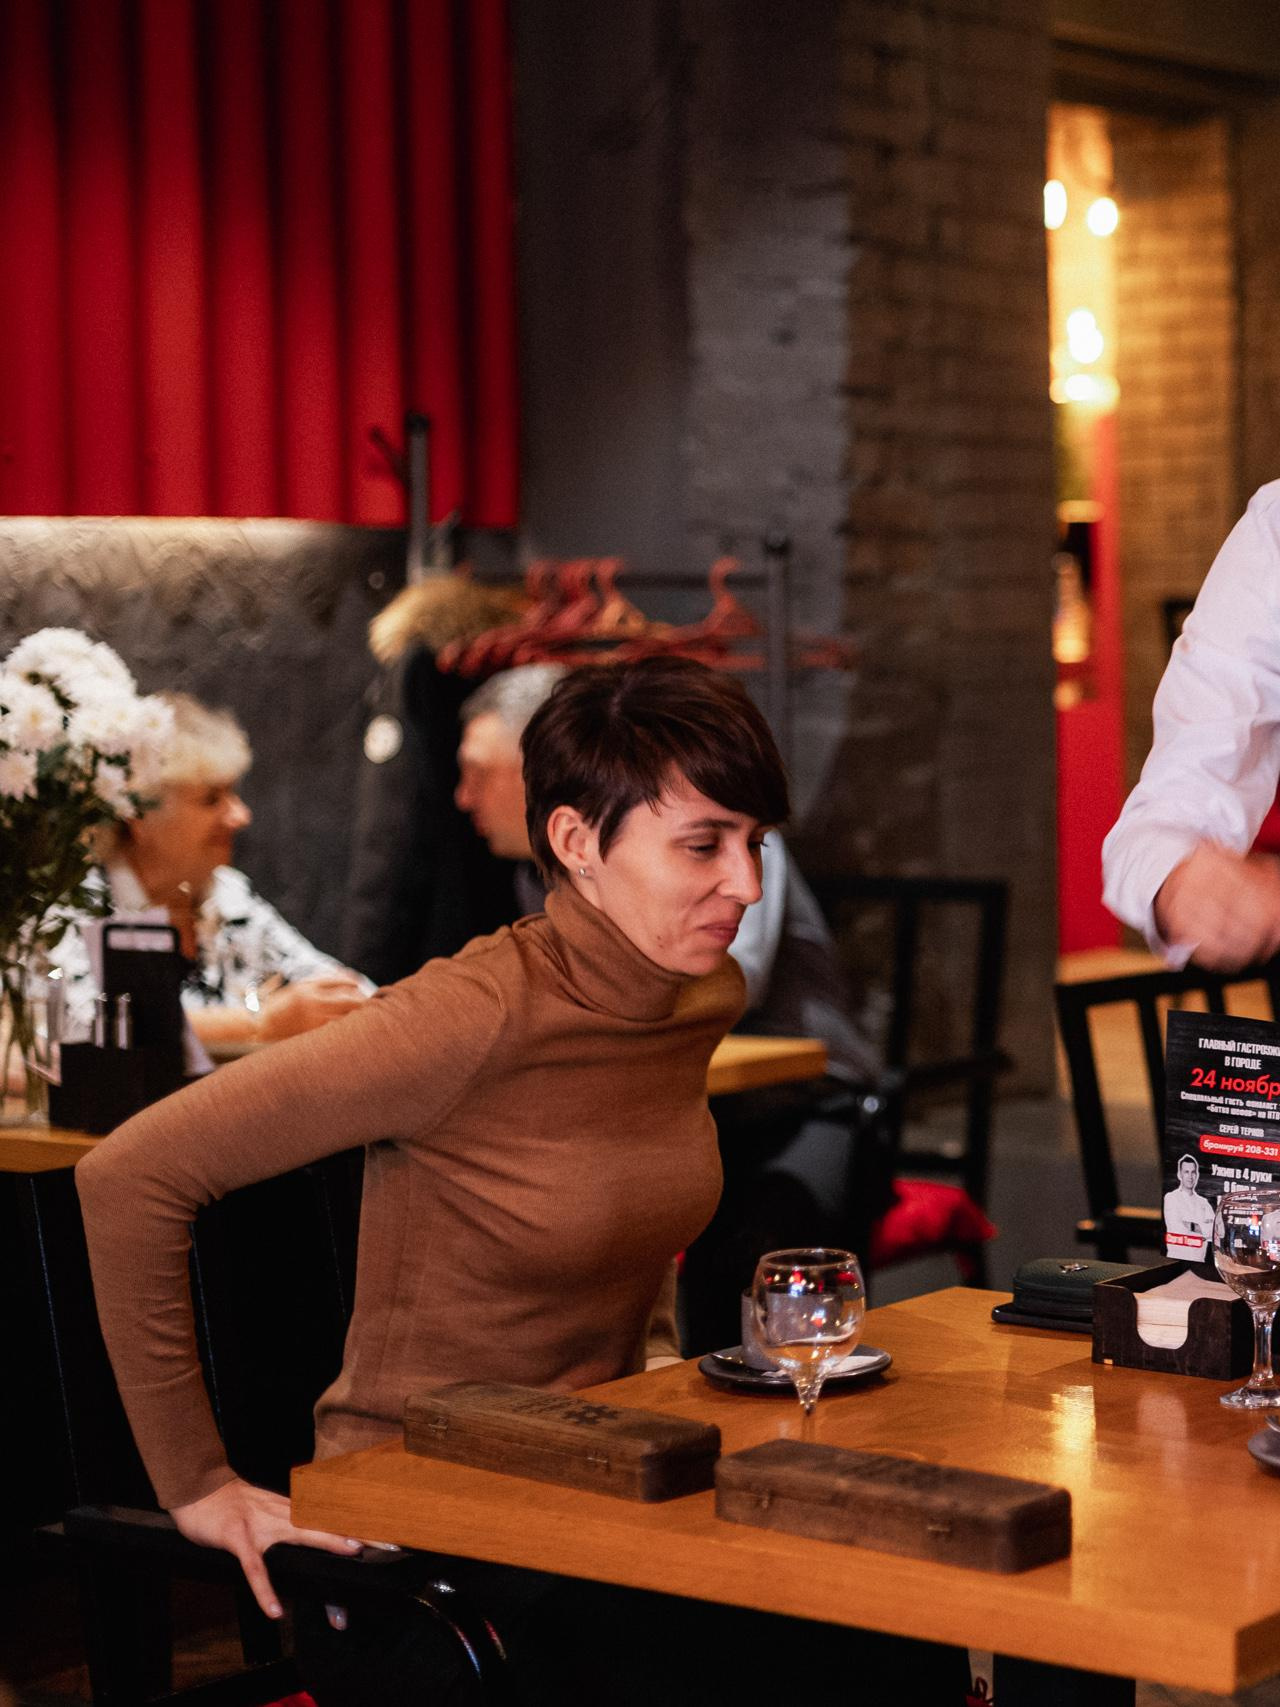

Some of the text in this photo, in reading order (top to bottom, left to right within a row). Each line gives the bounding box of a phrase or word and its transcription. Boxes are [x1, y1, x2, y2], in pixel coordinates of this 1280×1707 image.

[1198, 1038, 1236, 1052] ГЛАВНЫЙ
[1224, 1056, 1262, 1070] В ГОРОДЕ
[1190, 1067, 1216, 1088] 24
[1225, 1097, 1244, 1107] гость
[1203, 1139, 1279, 1157] бронируй 208-331
[1211, 1164, 1273, 1183] Ужин в 4 руки
